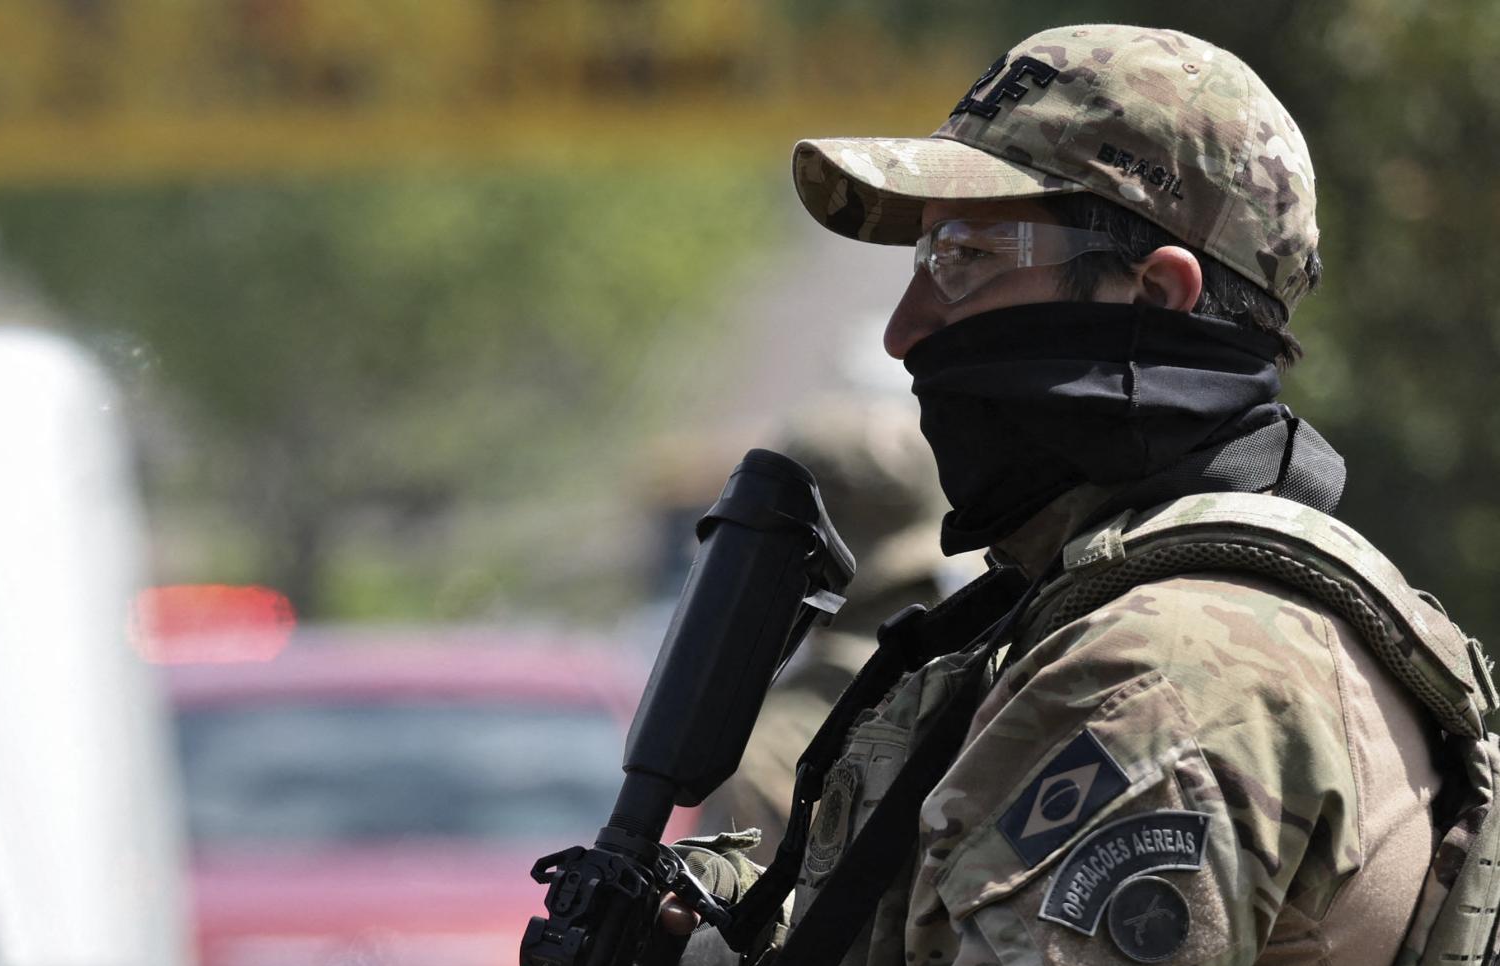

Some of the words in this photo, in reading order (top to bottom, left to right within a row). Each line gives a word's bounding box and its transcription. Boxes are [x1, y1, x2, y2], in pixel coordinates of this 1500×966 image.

[1097, 142, 1184, 200] BRASIL
[1062, 837, 1131, 920] OPERAÇÕES
[1132, 825, 1196, 856] AÉREAS
